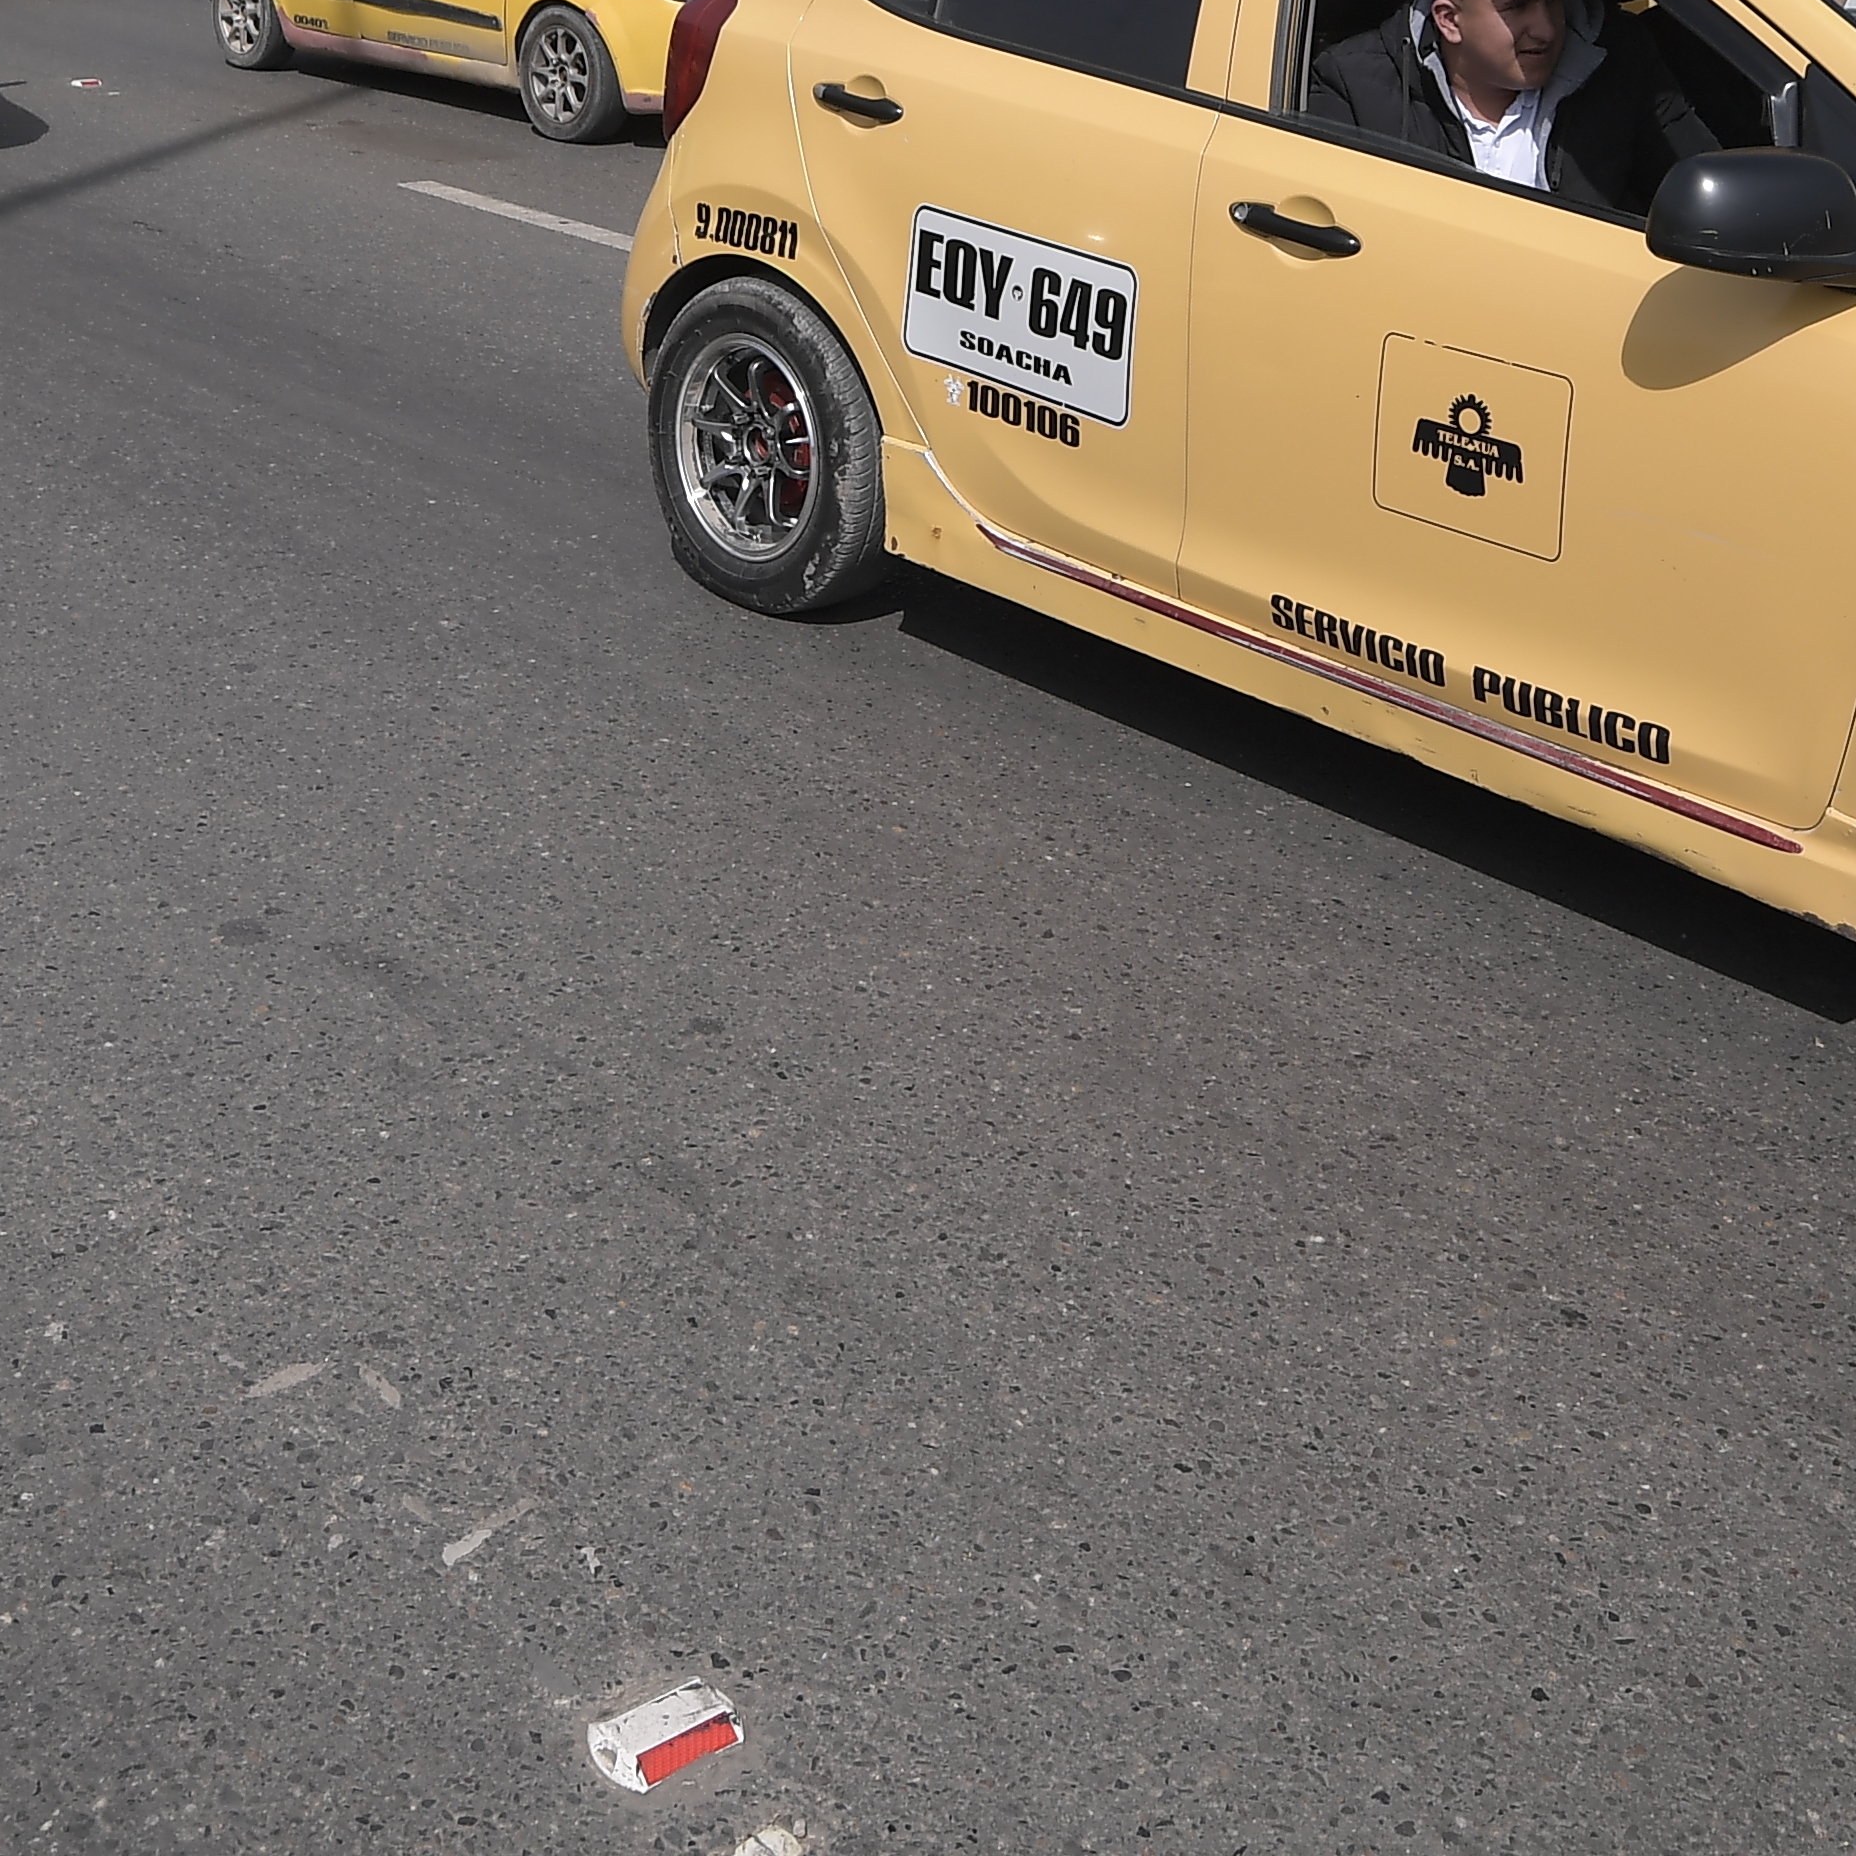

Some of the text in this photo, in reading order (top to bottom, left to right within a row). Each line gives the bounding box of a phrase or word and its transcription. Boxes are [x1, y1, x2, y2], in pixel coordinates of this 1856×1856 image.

[959, 330, 1073, 386] SOACHA
[966, 380, 1081, 448] 100106
[1270, 593, 1673, 765] SERVICIO PUBLICO
